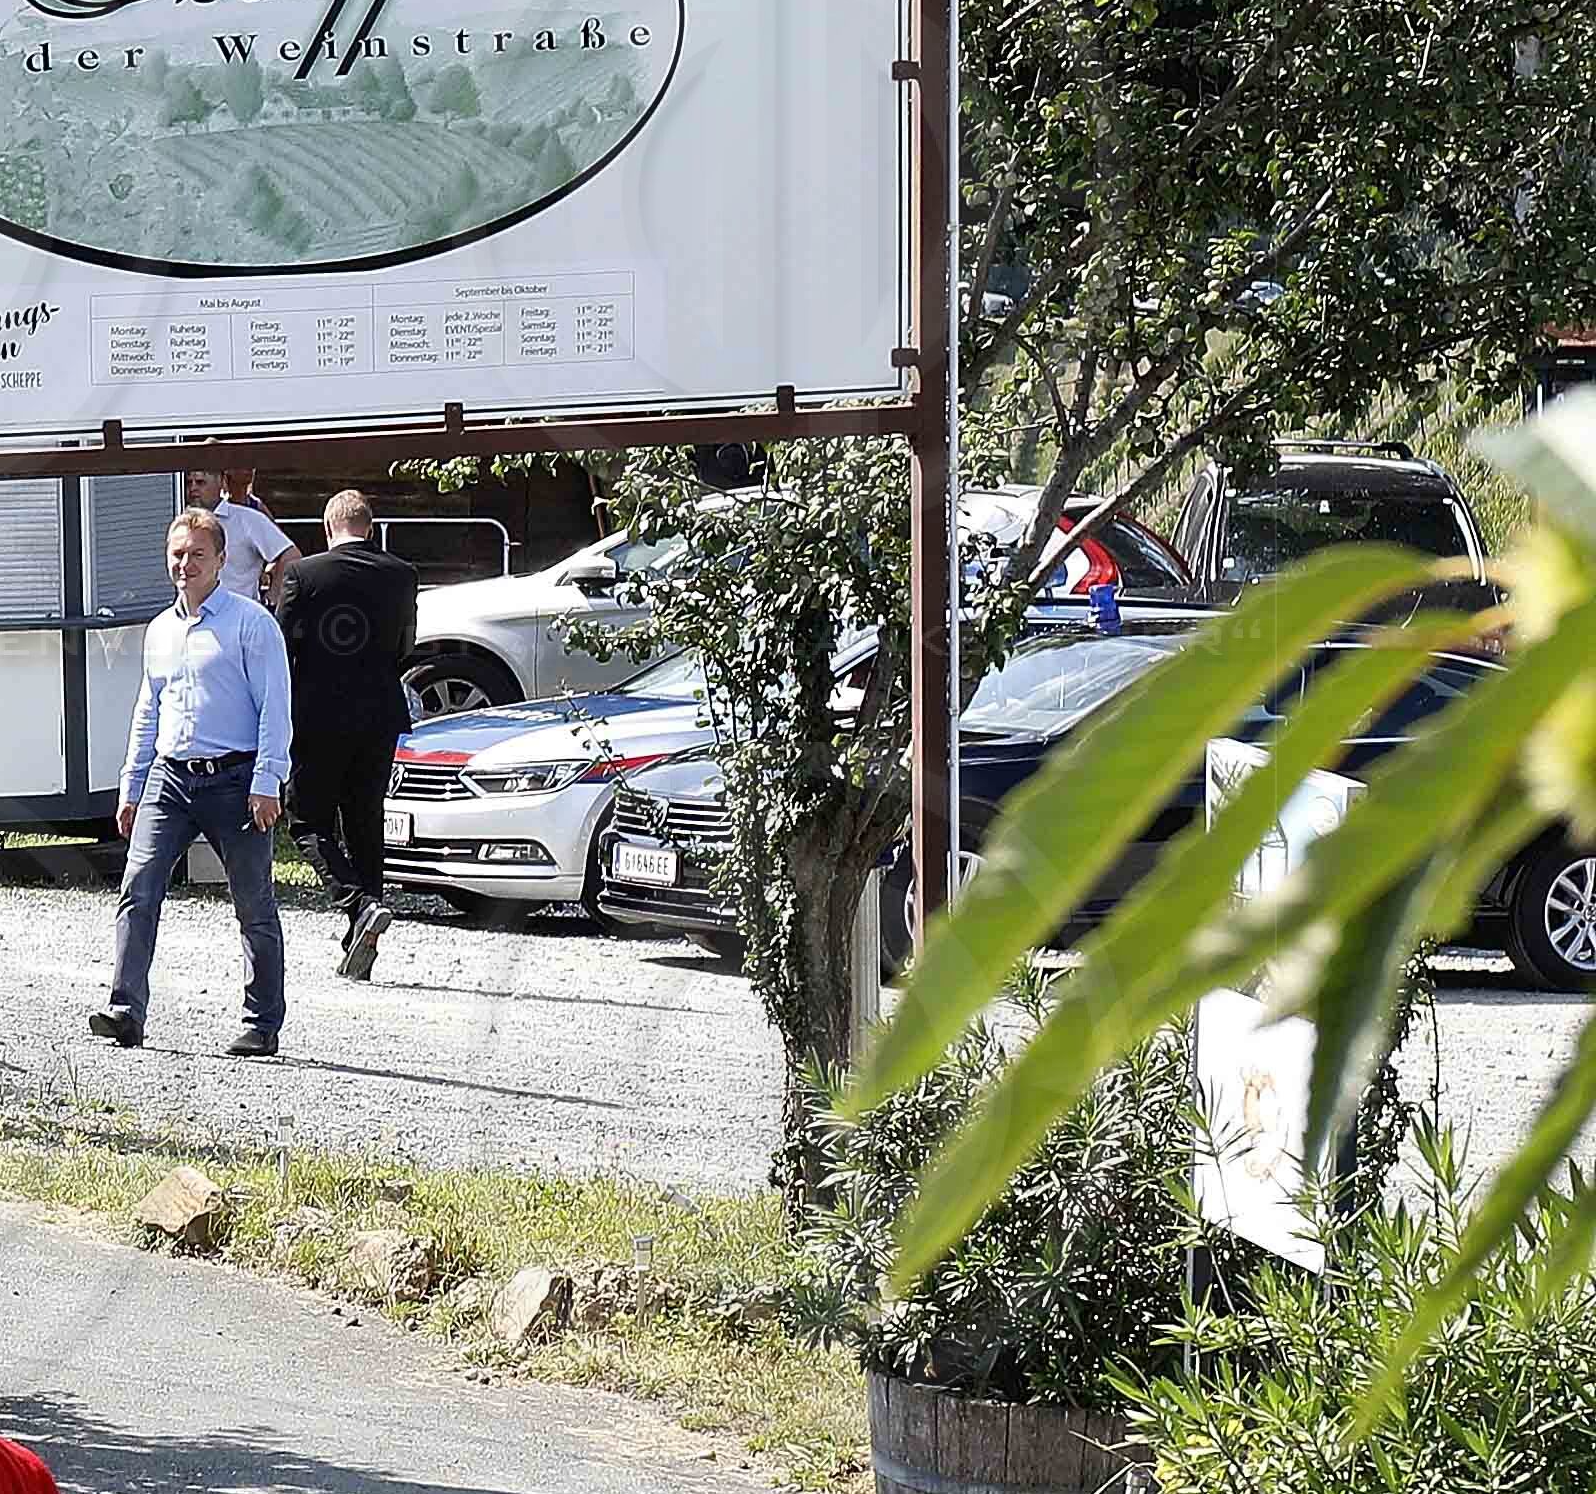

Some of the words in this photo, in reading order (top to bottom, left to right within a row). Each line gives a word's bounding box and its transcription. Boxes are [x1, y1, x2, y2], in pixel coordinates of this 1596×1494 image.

[25, 41, 145, 74] der
[213, 17, 655, 67] Weinstraße
[231, 298, 261, 309] August
